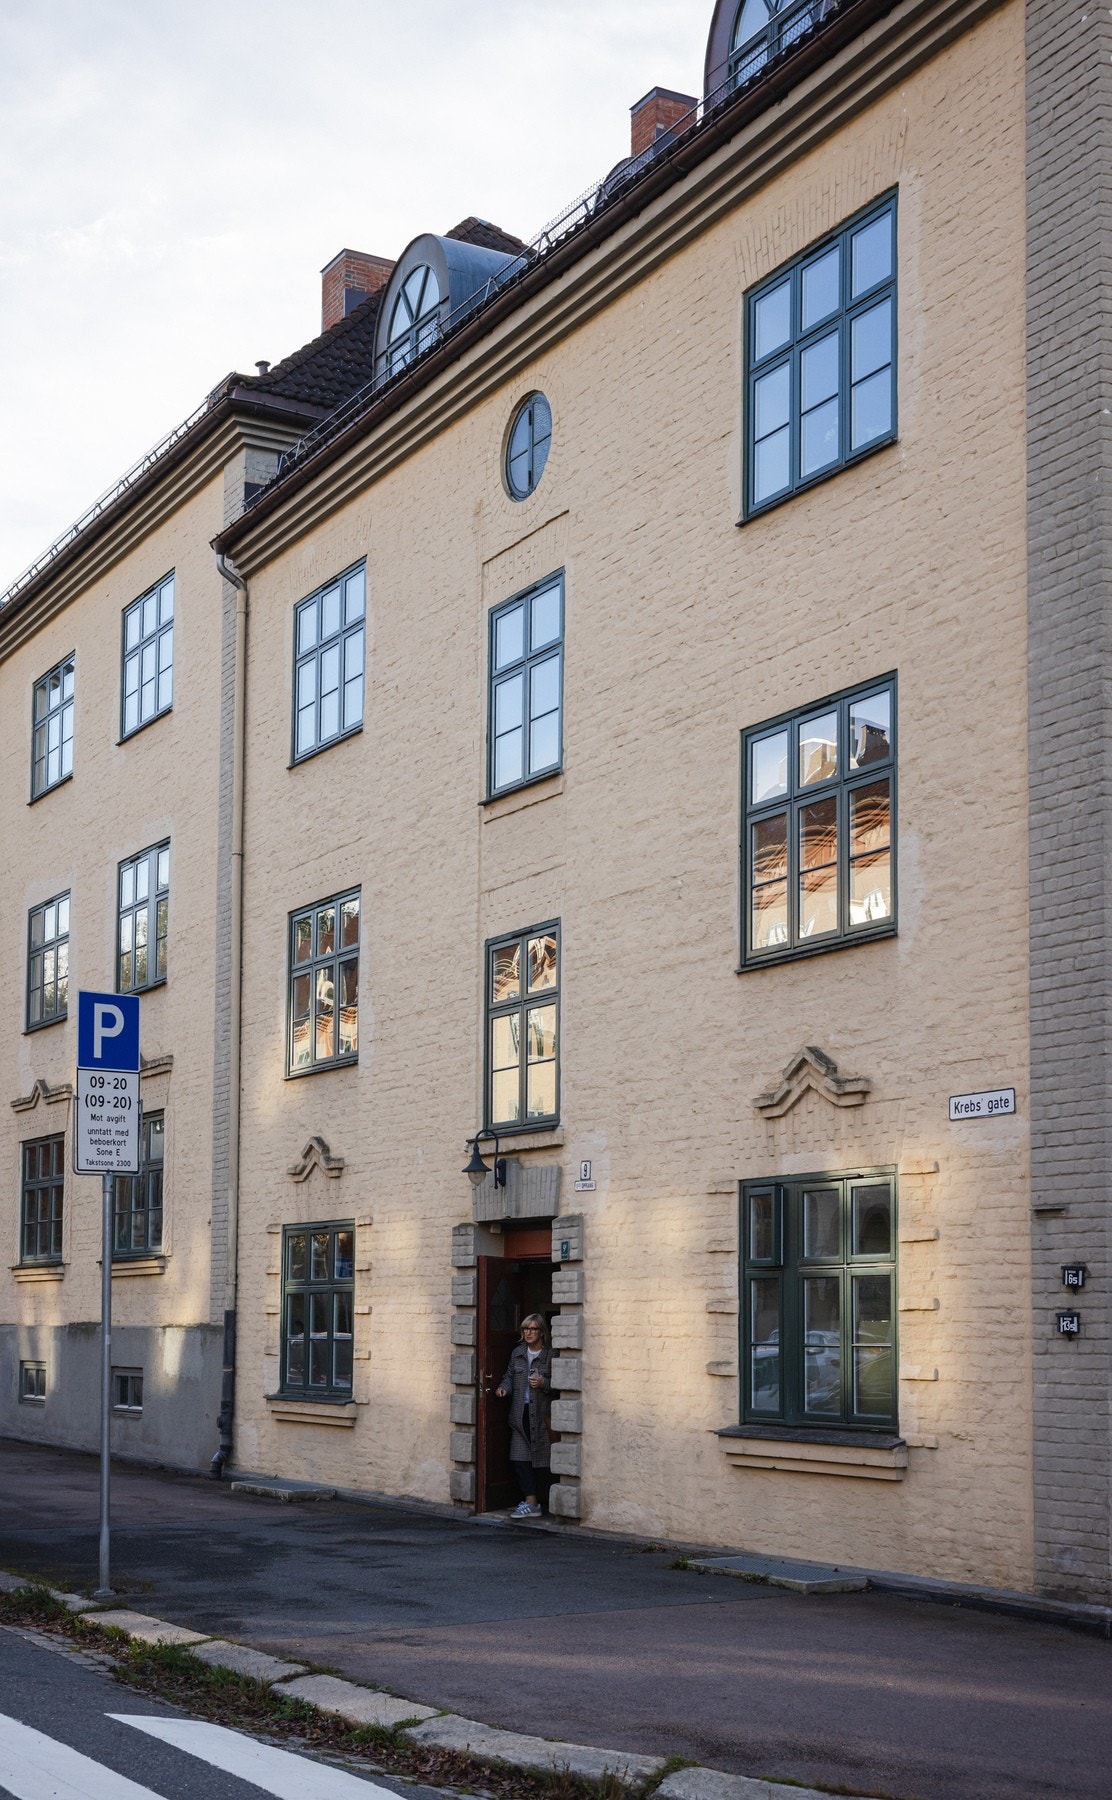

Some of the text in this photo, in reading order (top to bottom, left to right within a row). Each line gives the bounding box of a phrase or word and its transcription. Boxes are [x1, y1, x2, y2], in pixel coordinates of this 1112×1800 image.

[93, 1002, 125, 1059] P
[987, 1096, 1010, 1113] gate
[90, 1113, 126, 1125] Mot avgift
[87, 1128, 129, 1137] unntatt med
[89, 1137, 127, 1147] beboerkort
[96, 1147, 121, 1157] Sone E
[85, 1158, 114, 1167] Takstsone
[583, 1163, 588, 1178] 9
